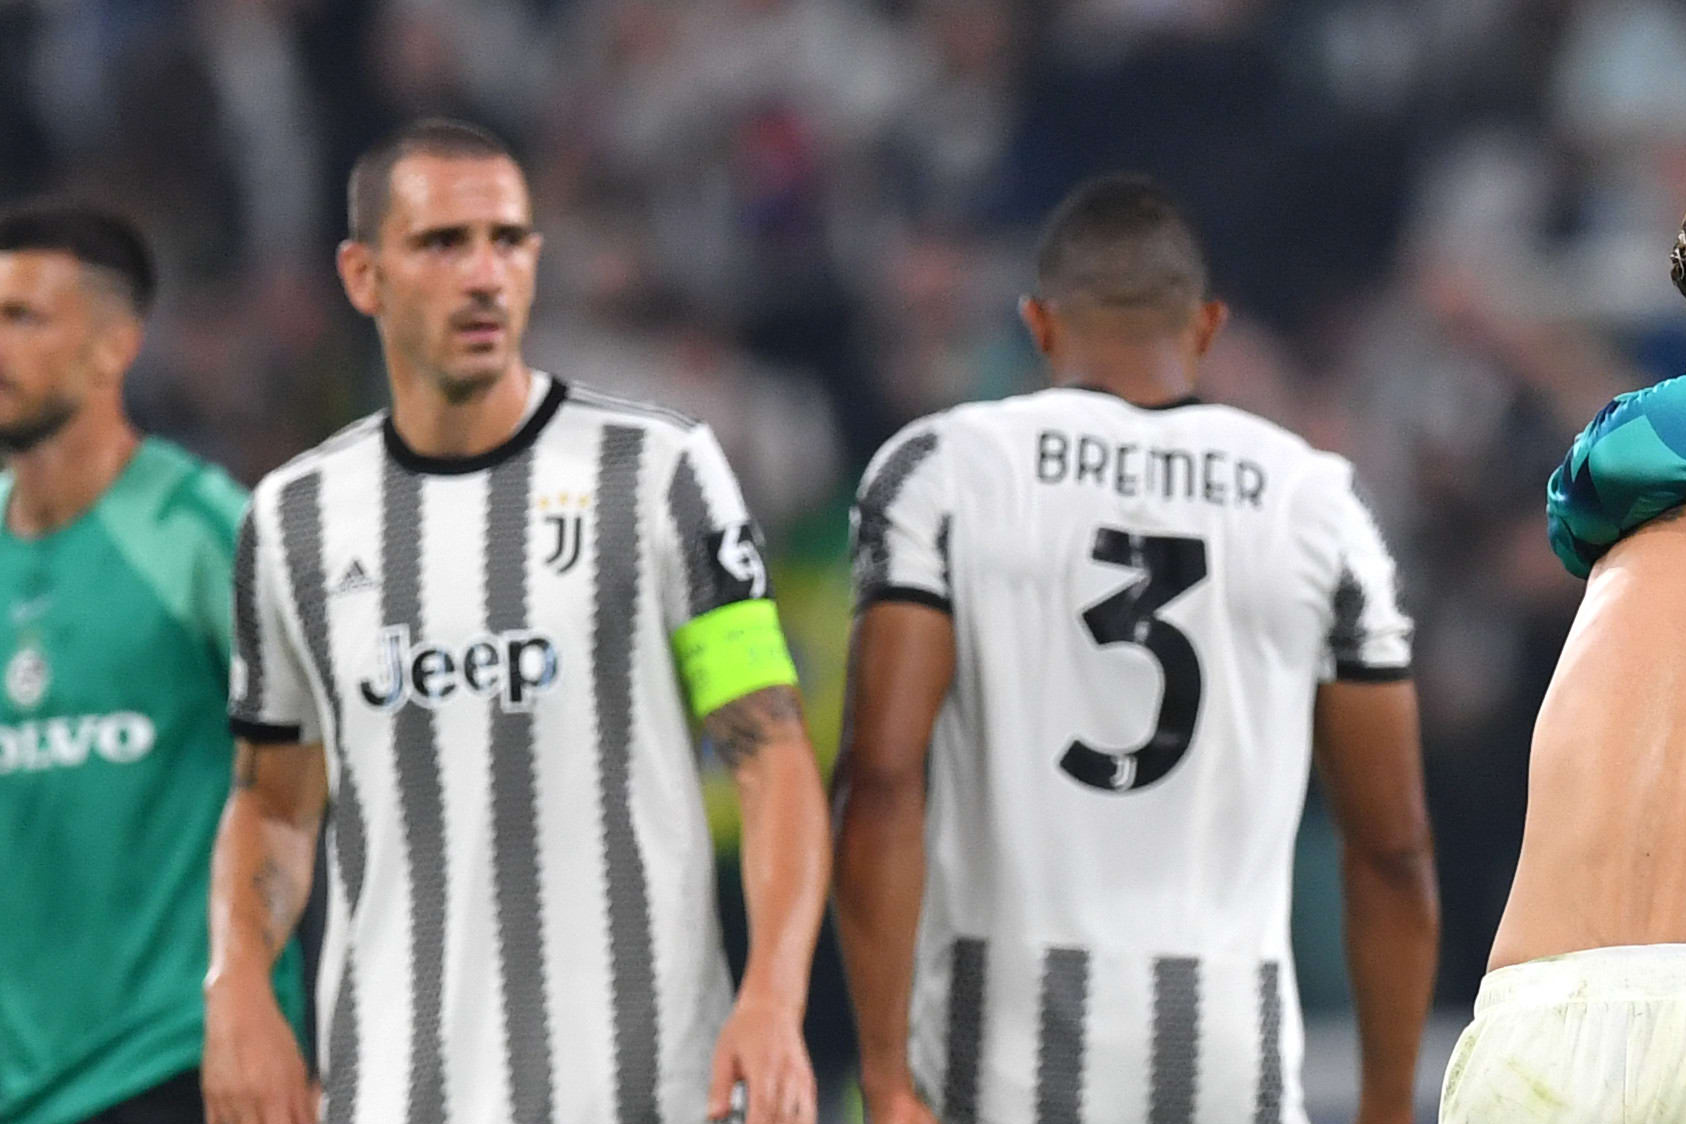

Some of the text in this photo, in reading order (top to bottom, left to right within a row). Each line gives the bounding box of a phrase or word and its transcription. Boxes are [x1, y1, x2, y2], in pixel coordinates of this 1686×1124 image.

[1037, 430, 1267, 507] BREMER
[360, 632, 560, 705] Jeep
[1059, 527, 1208, 793] 3
